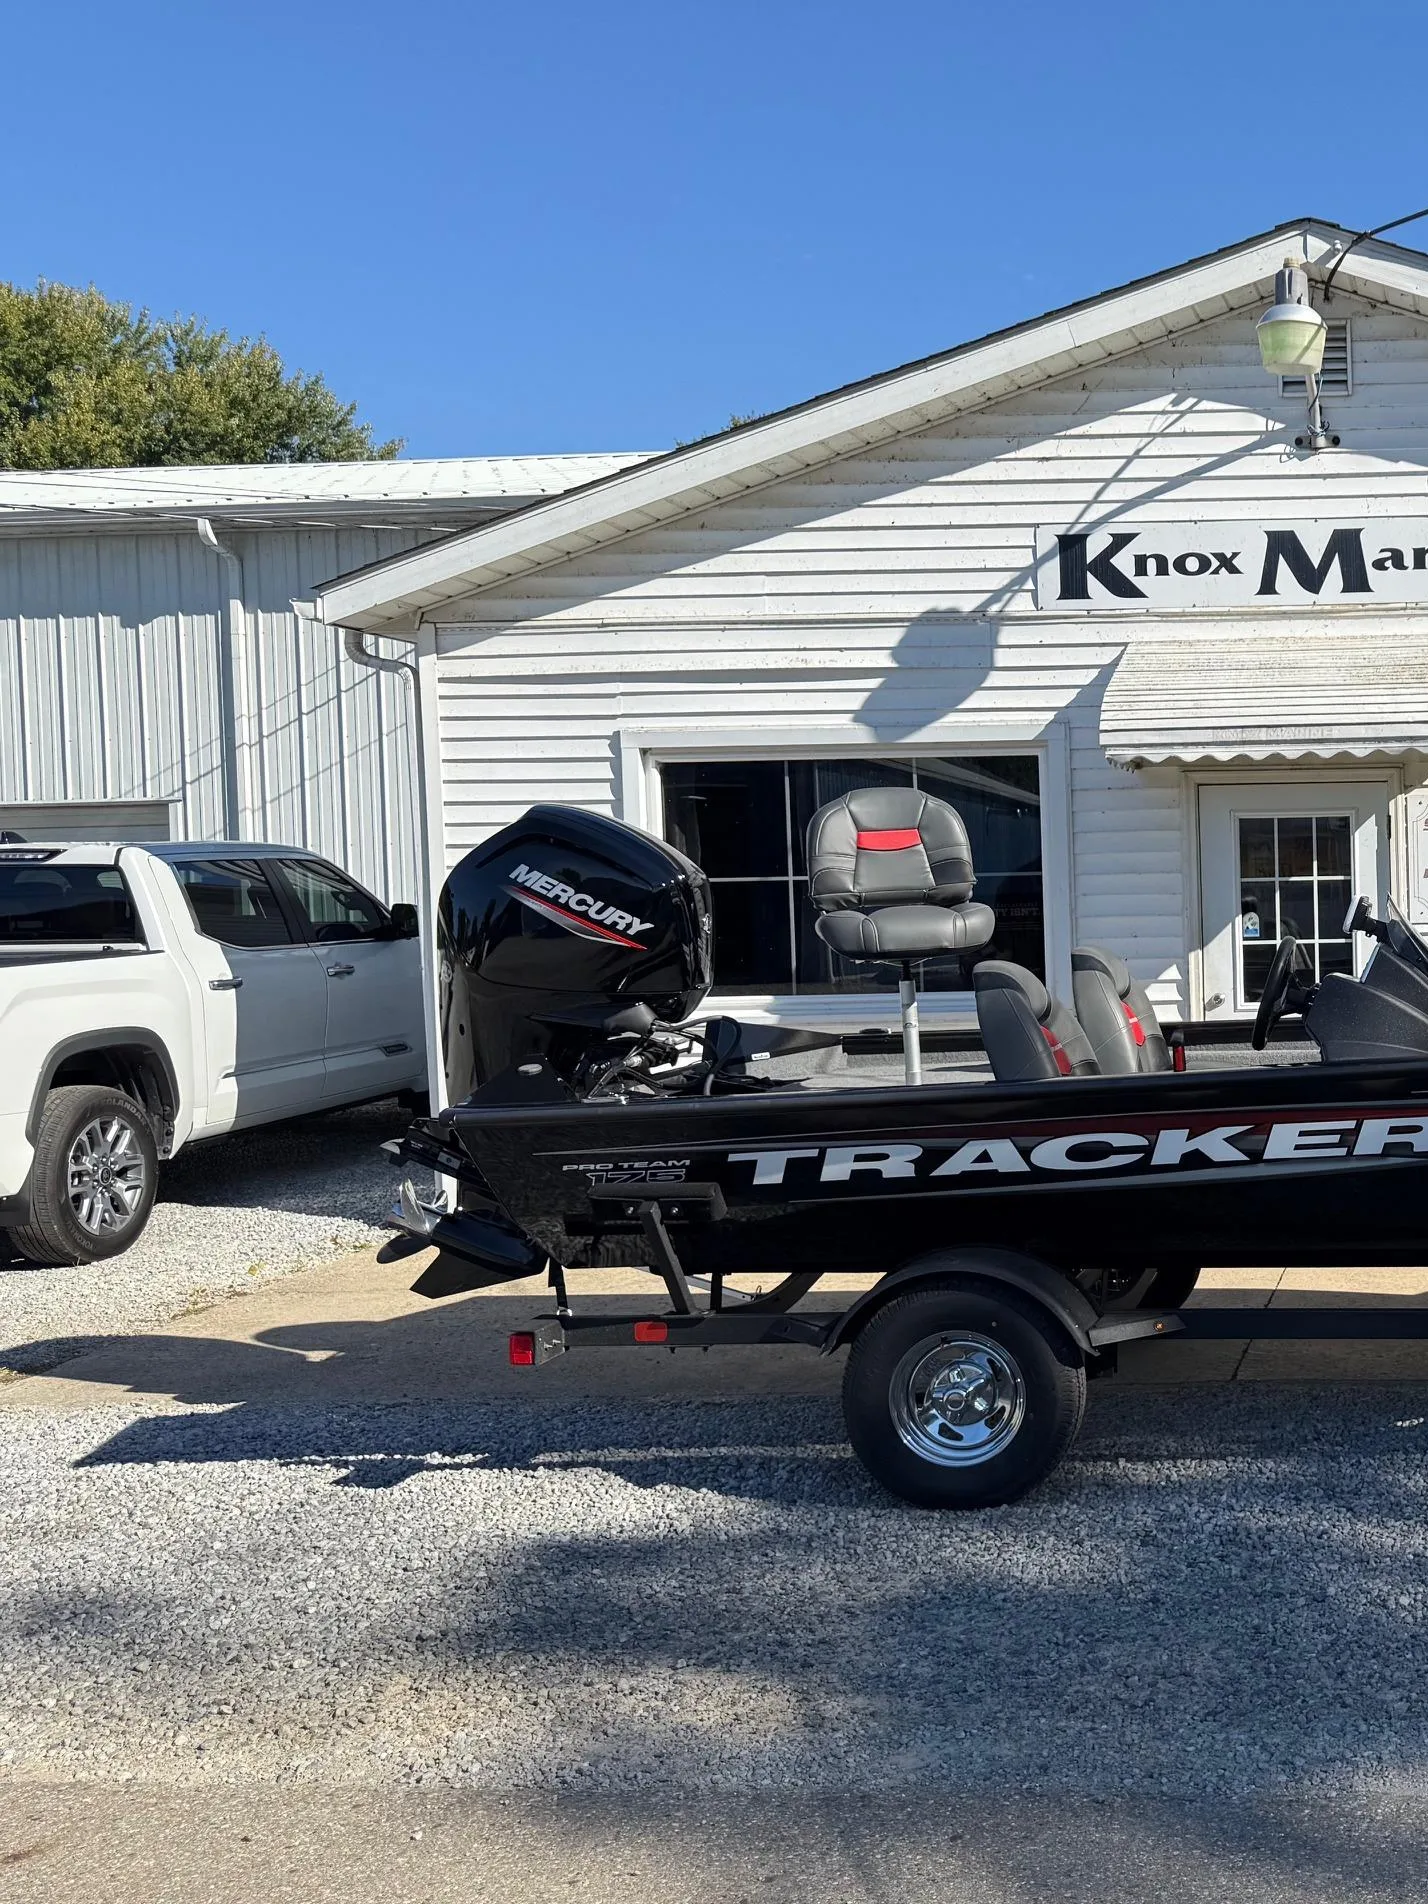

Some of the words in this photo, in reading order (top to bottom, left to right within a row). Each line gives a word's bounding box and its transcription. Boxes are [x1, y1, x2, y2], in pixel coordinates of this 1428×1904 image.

[1055, 531, 1243, 601] Knox
[508, 863, 655, 936] MERCURY
[562, 1162, 614, 1171] PRO
[618, 1159, 691, 1169] TEAM
[585, 1168, 686, 1187] 175
